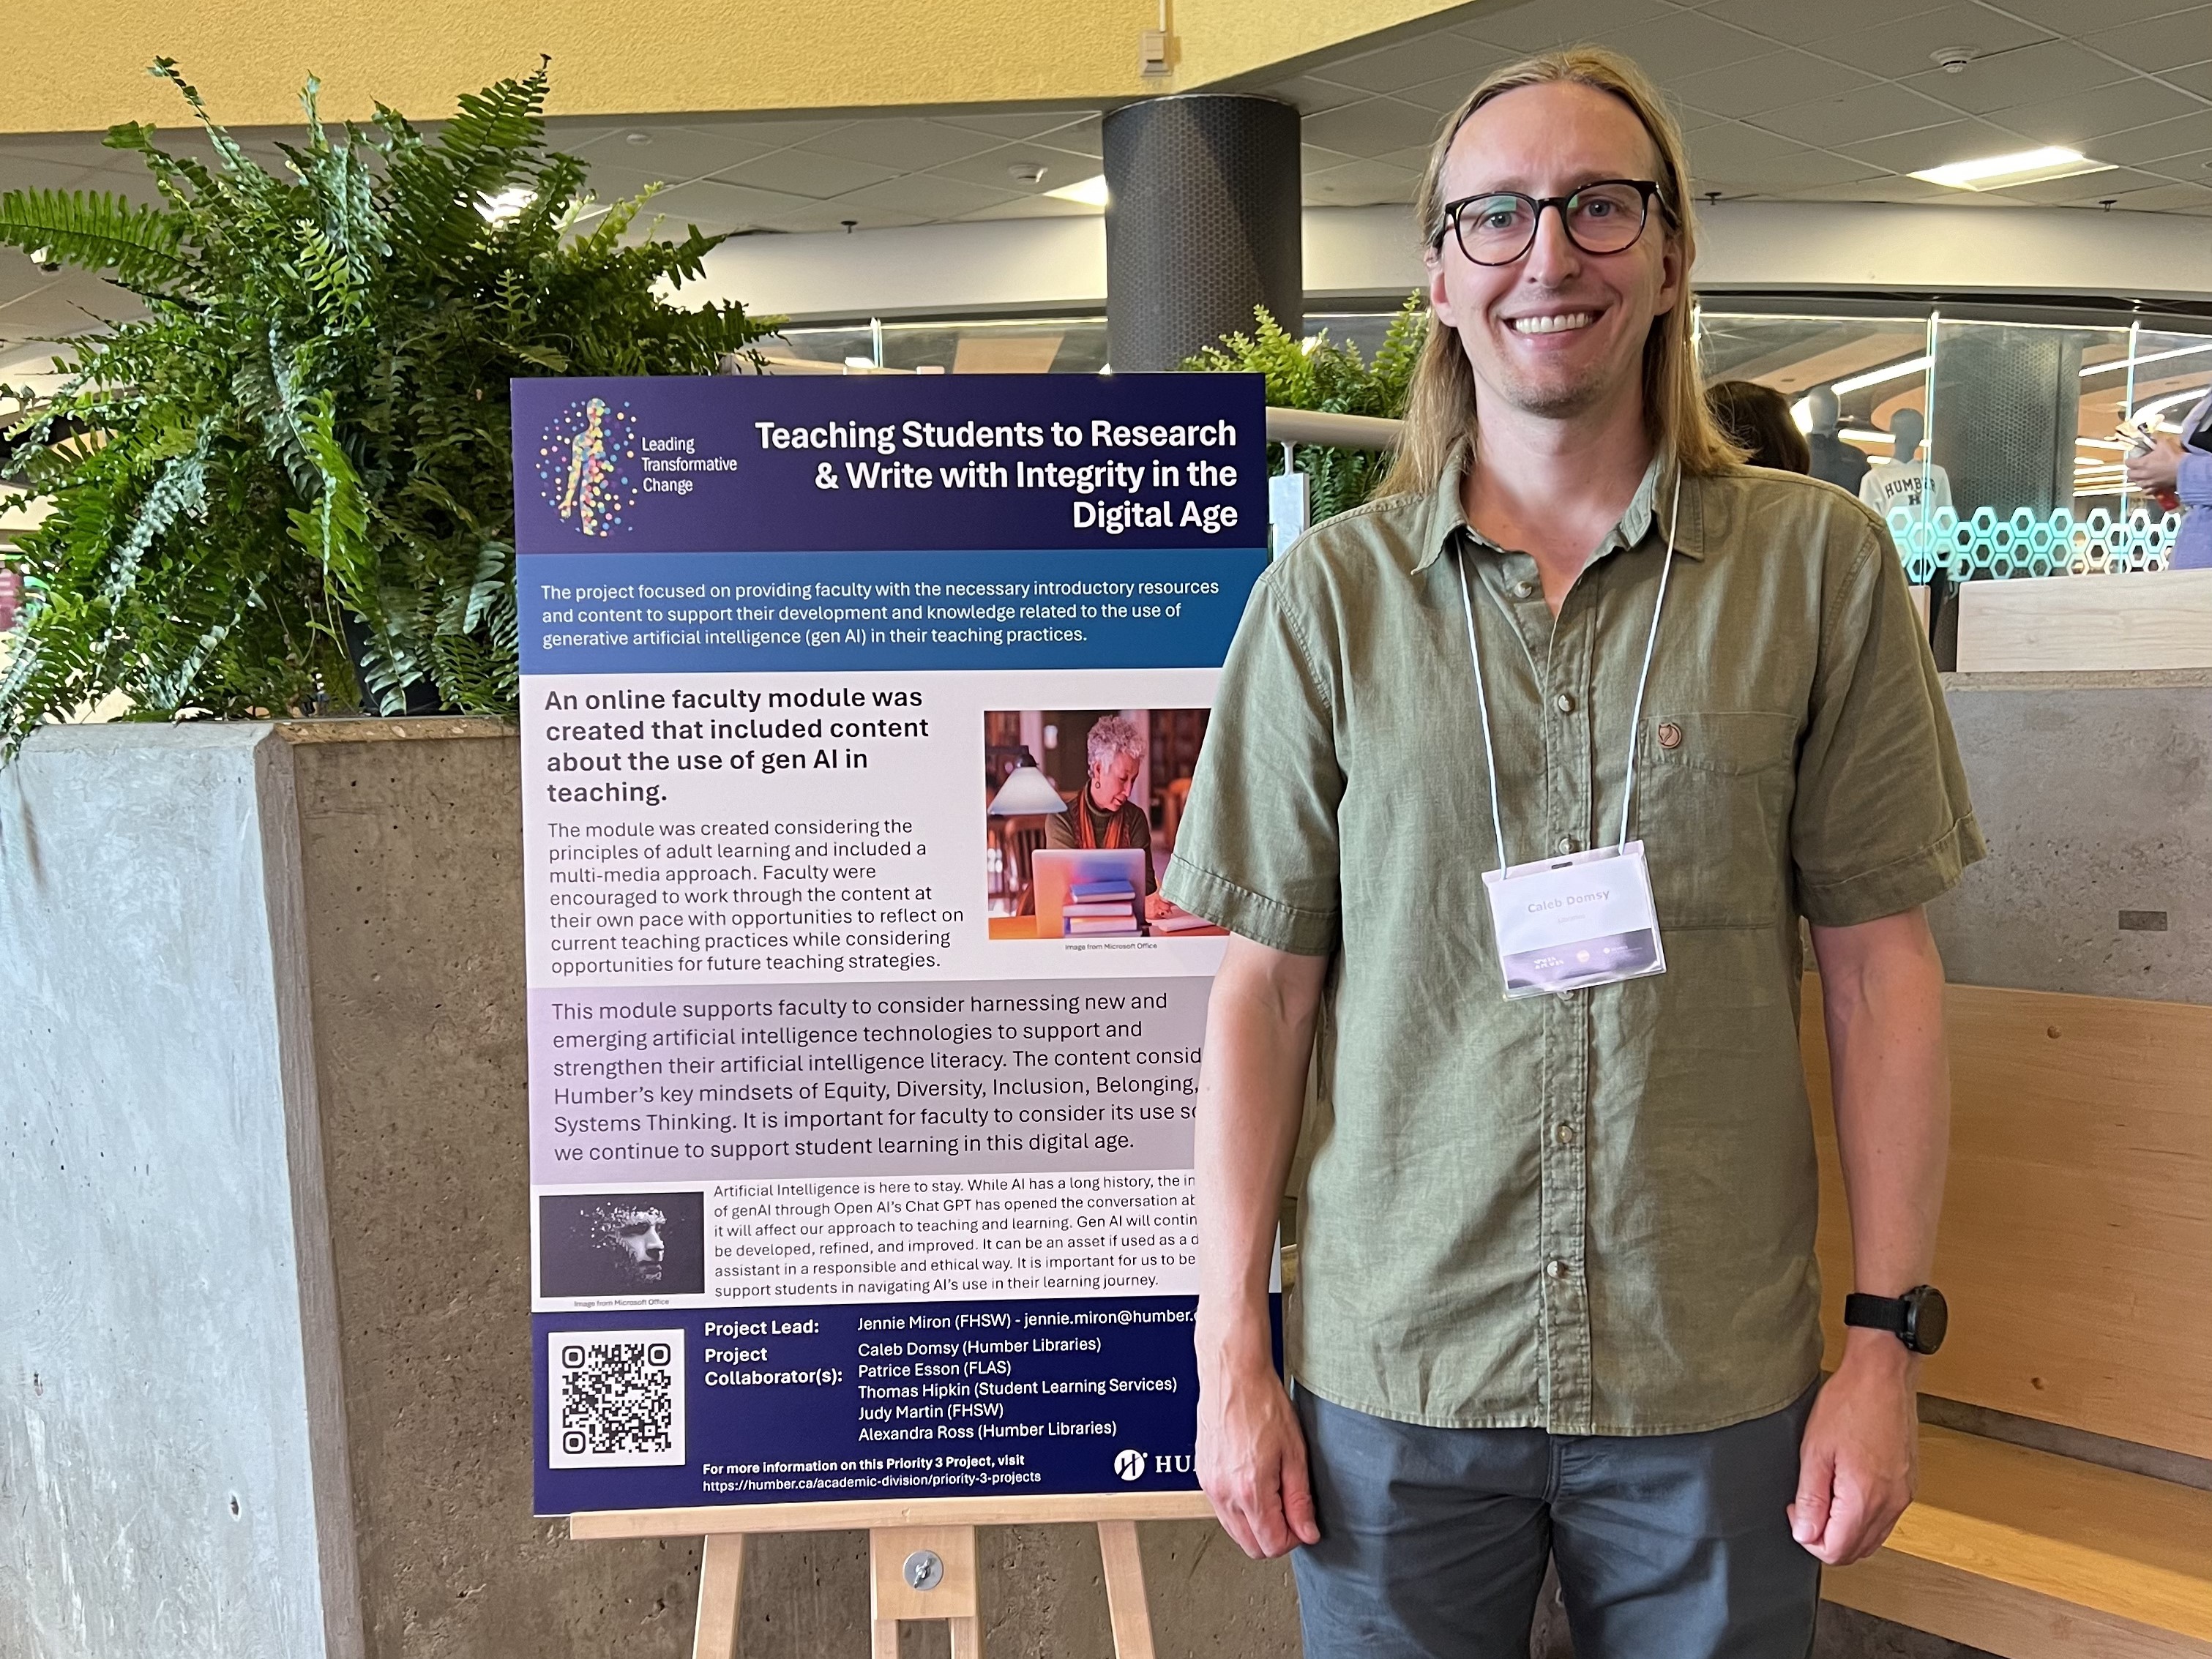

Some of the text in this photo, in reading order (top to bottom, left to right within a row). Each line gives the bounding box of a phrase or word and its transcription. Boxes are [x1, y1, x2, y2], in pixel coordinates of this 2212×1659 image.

[643, 437, 695, 454] Leading
[755, 420, 1236, 454] Teaching Students to Research
[642, 457, 737, 471] Transformative
[643, 478, 692, 495] Change
[815, 460, 1236, 493] & Write with Integrity in the
[1074, 501, 1237, 534] Digital Age
[541, 581, 1219, 602] The project focused on providing faculty with the necessary introductory resources
[543, 627, 1086, 649] generative artificial intelligence (gen AI) in their teaching practices.
[545, 688, 922, 712] An online faculty module was
[547, 719, 928, 741] created that included content
[548, 749, 867, 774] about the use of gen AI in
[548, 782, 666, 806] teaching.
[548, 819, 911, 837] The module was created considering the
[550, 865, 875, 884] multi-media approach. Faculty were
[1528, 891, 1610, 913] Caleb Domsy
[1065, 944, 1086, 952] Image
[554, 1021, 1141, 1051] emerging artificial intelligence technologies to support and
[556, 1076, 1197, 1105] Humber’s key mindsets of Equity, Diversity, Inclusion, Belonging,
[715, 1215, 1197, 1237] it will affect our approach to teaching and learning. Gen AI will contin
[716, 1276, 1158, 1298] support students in navigating AI’s use in their learning journey.
[706, 1319, 818, 1338] Project Lead:
[858, 1317, 905, 1330] Jennie
[910, 1316, 950, 1328] Miron
[955, 1314, 1010, 1330] (FHSW)
[706, 1347, 767, 1365] Project
[859, 1337, 1101, 1357] Caleb Domsy (Humber Libraries)
[706, 1368, 842, 1385] Collaborator(s):
[859, 1360, 1011, 1377] Patrice Esson (FLAS)
[858, 1377, 1176, 1399] Thomas Hipkin (Student Learning Services)
[859, 1403, 1003, 1422] Judy Martin (FHSW)
[859, 1421, 1116, 1441] Alexandra Ross (Humber Libraries)
[703, 1454, 1024, 1475] For more information on this Priority 3 Project, visit
[1156, 1455, 1196, 1473] HU
[703, 1470, 1042, 1493] https://humber.ca/academic-division/priority-3-projects
